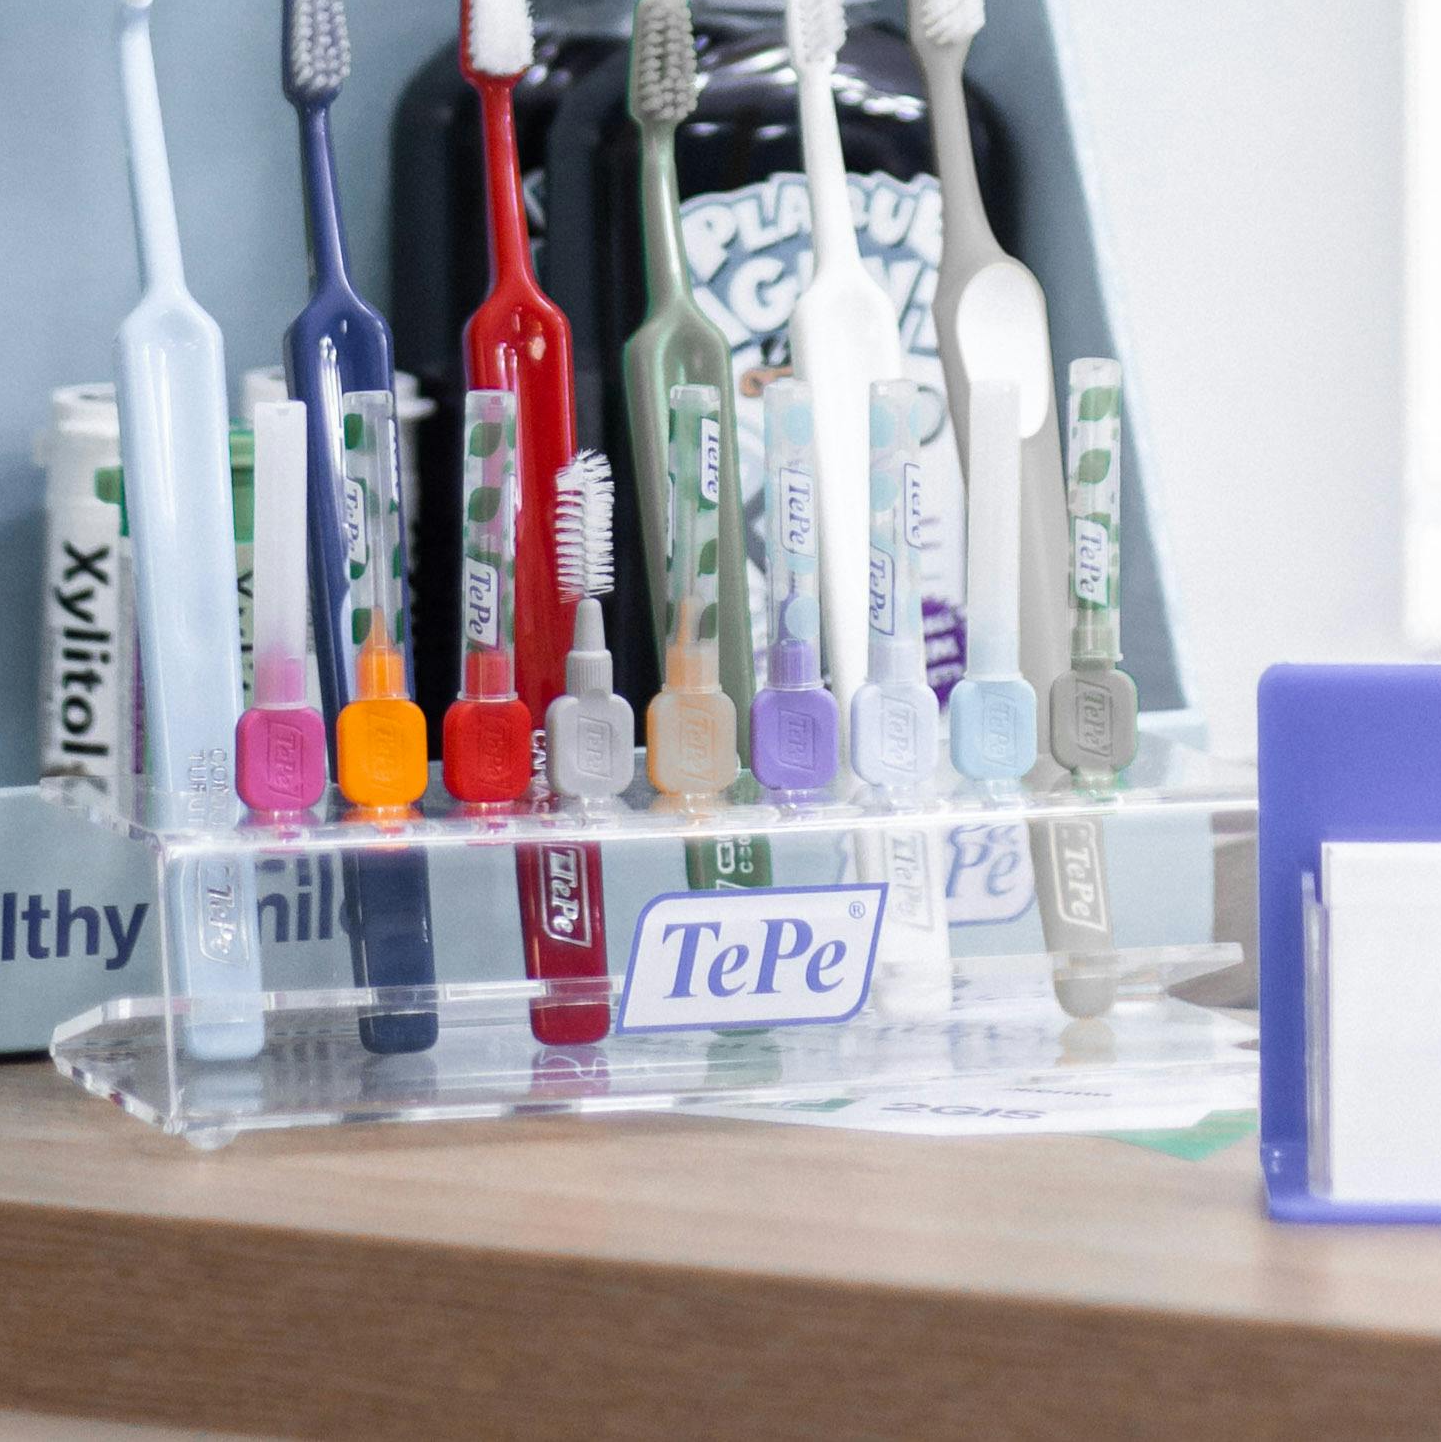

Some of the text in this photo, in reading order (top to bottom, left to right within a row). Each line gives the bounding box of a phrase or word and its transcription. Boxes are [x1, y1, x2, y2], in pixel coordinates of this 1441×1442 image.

[788, 482, 811, 546] TePe
[1078, 530, 1104, 594] TePe
[469, 571, 493, 646] TePe
[54, 541, 112, 757] Xylitol
[1063, 846, 1095, 917] TePe
[661, 916, 848, 999] TePe
[880, 1101, 1048, 1120] 2GIS
